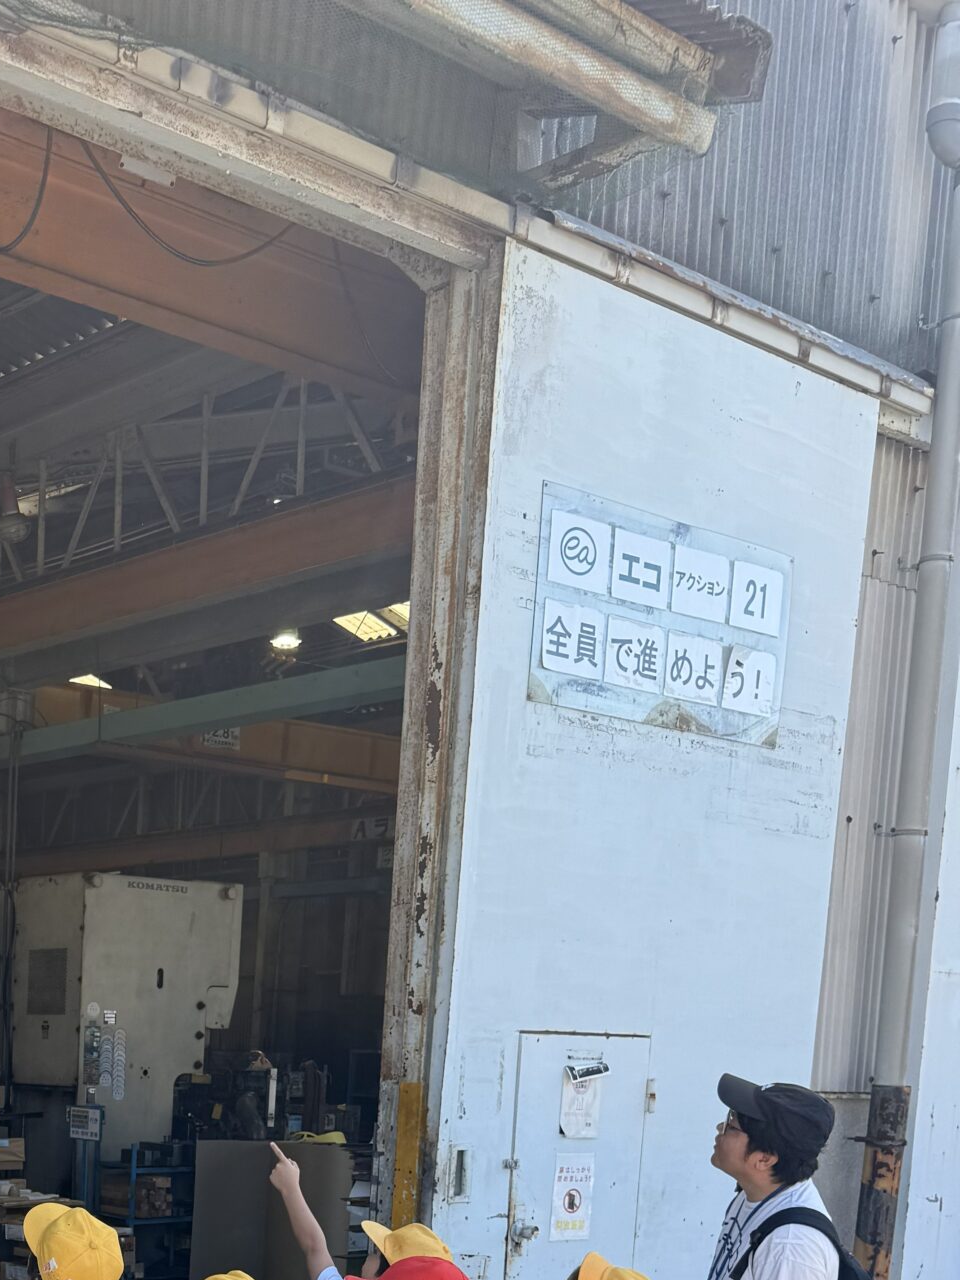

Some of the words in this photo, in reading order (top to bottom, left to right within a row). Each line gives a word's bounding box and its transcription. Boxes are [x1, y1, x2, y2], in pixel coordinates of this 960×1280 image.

[545, 615, 761, 700] 全員で進めよう!
[127, 880, 189, 894] KOMATSU
